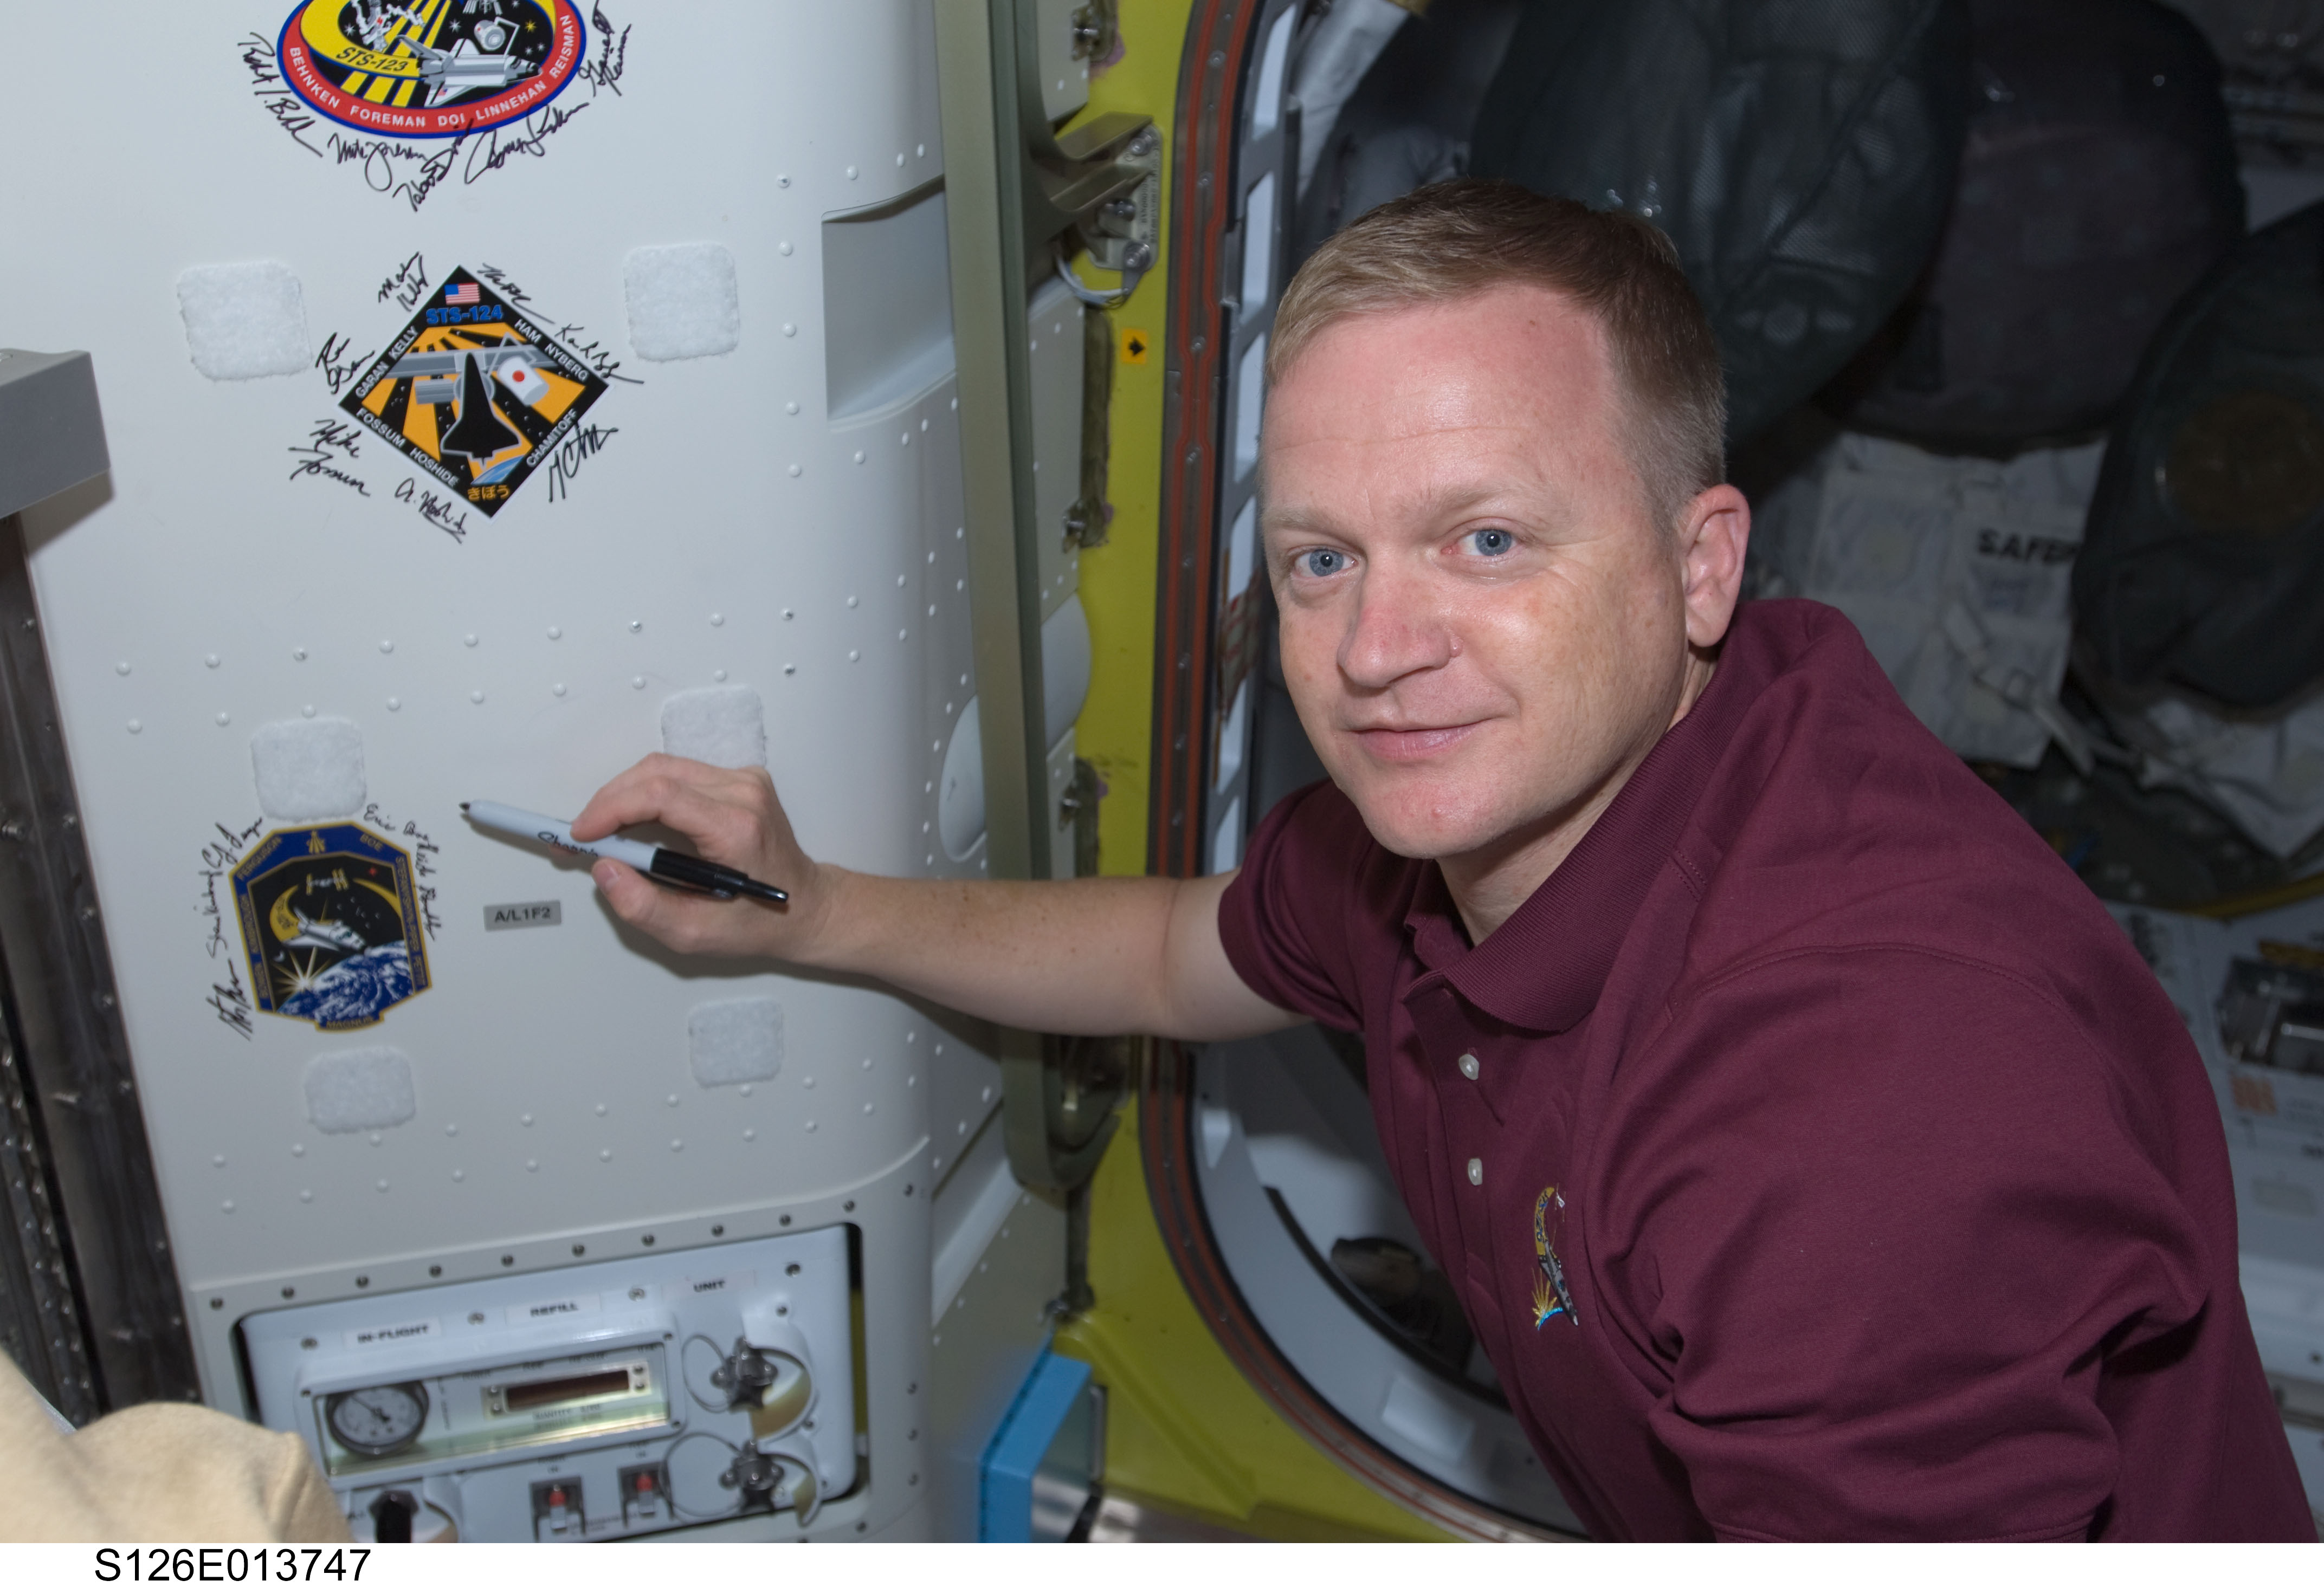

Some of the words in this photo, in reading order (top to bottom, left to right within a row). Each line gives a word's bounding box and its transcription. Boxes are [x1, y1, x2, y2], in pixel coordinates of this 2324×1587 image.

[290, 47, 340, 109] BEHNKEN
[350, 105, 425, 127] FOREMAN
[438, 114, 465, 126] DOI
[476, 81, 546, 120] LINNEHAN
[549, 15, 574, 79] REISMAN
[336, 47, 408, 71] STS-123
[426, 305, 503, 325] STS-124
[355, 361, 390, 398] GARAN
[388, 325, 418, 361] KELLY
[514, 319, 542, 344] HAM
[544, 342, 589, 381] NYBERG
[356, 407, 405, 448] FOSSUM
[409, 447, 460, 488] HOSHIDE
[526, 408, 578, 467] CHAMITOFF
[468, 484, 510, 501] きぼう
[359, 833, 383, 852] BOE
[494, 907, 552, 923] A/L1F2
[358, 1324, 429, 1343] IN-FLIGHT
[530, 1302, 578, 1317] REFILL
[693, 1279, 726, 1293] UNIT
